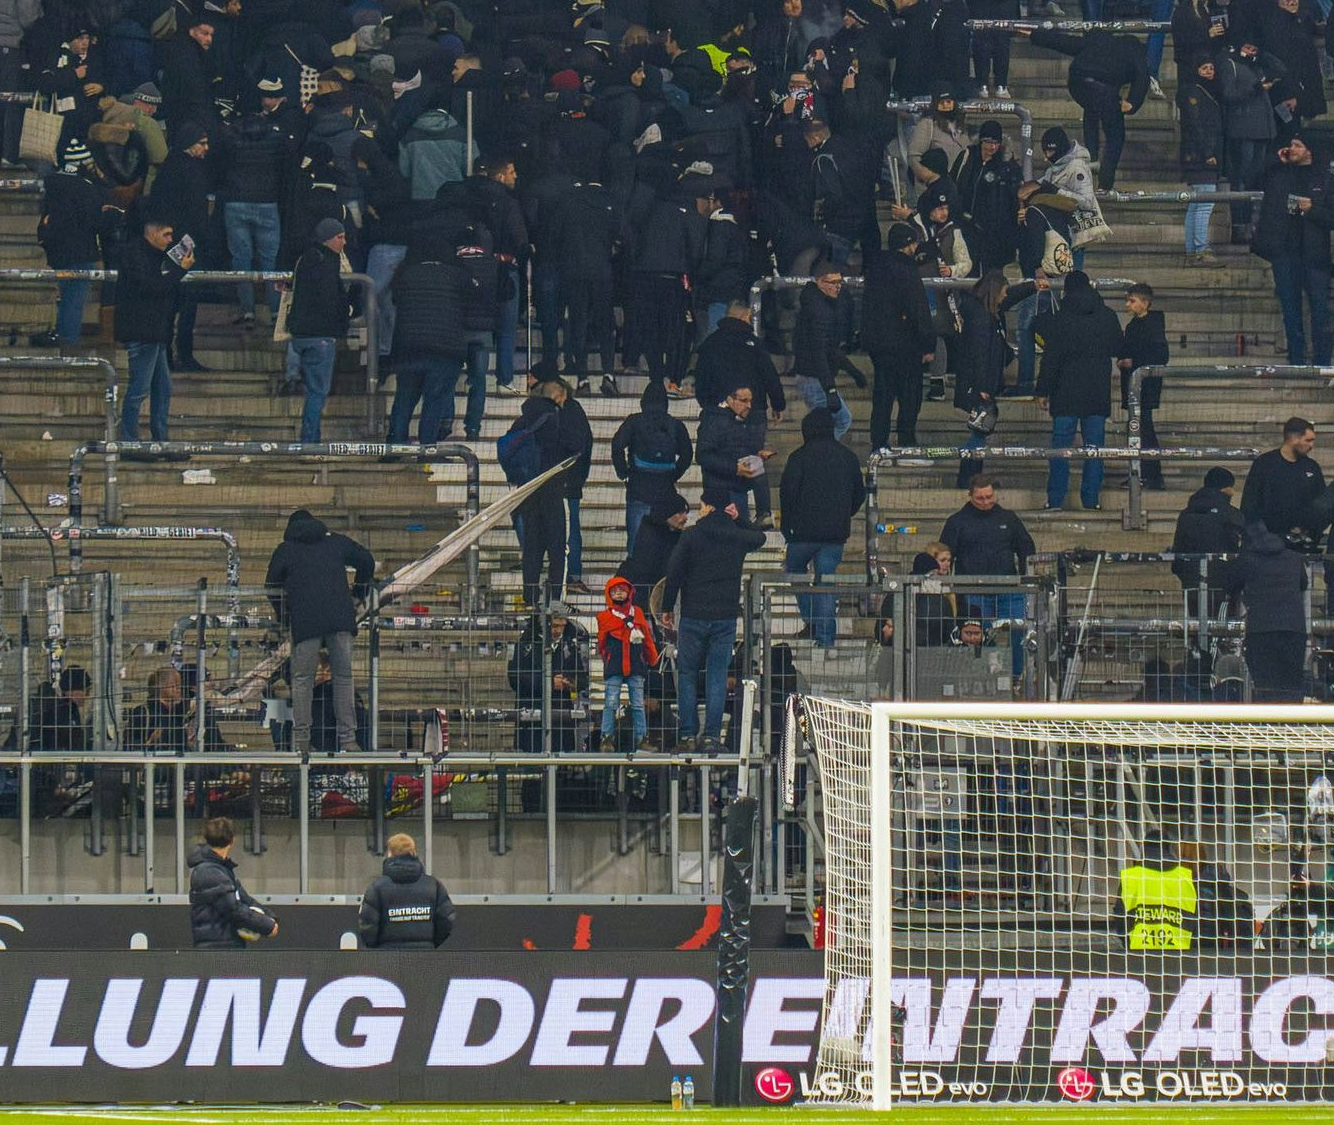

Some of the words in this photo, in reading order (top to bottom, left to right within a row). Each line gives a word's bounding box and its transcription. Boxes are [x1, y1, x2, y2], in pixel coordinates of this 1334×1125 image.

[388, 907, 431, 916] EINTRACHT
[1142, 930, 1175, 946] 2192
[427, 977, 716, 1066] DER
[799, 1071, 843, 1096] LG
[949, 1082, 987, 1095] evo
[1101, 1072, 1145, 1096] LG
[1156, 1071, 1244, 1097] OLED
[1249, 1083, 1287, 1096] evo
